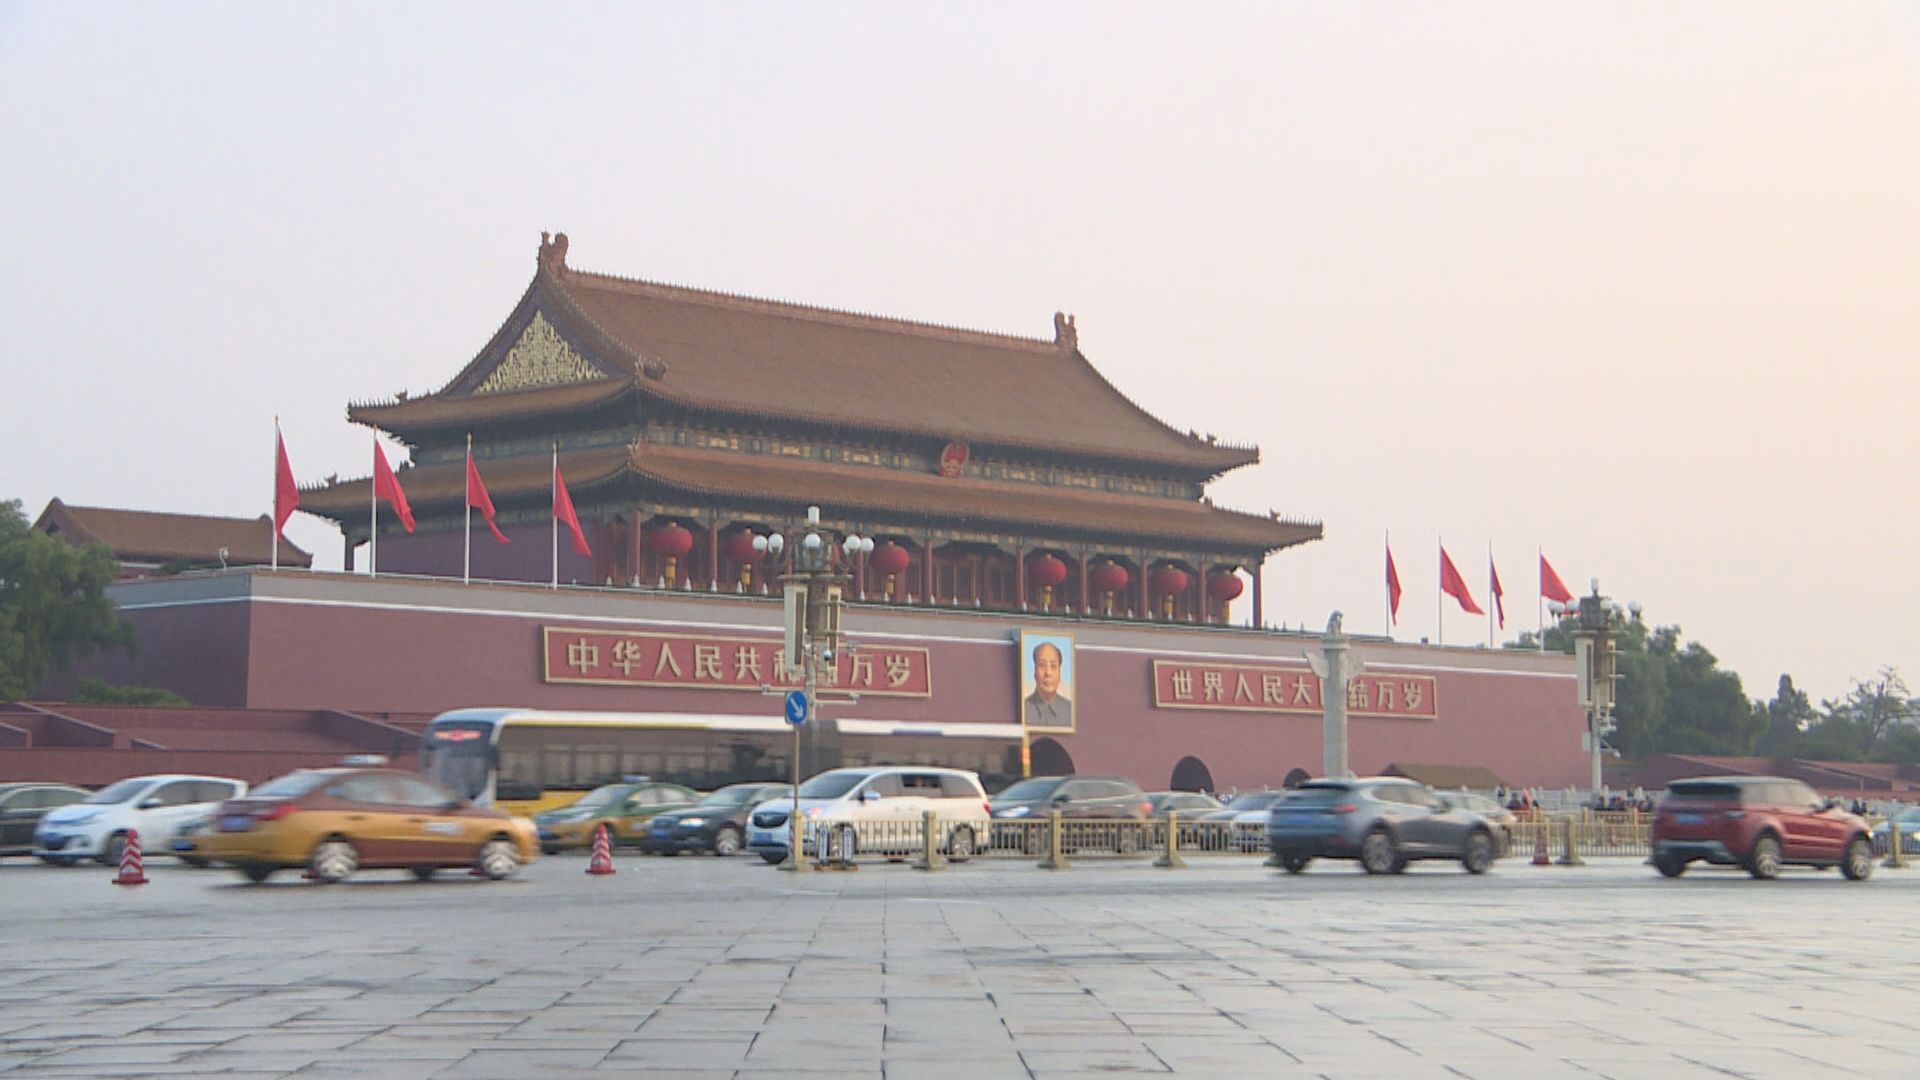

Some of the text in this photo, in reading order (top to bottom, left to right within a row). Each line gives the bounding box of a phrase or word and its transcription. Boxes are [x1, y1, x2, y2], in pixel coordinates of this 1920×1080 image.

[1172, 669, 1422, 710] 世界人民大结万岁
